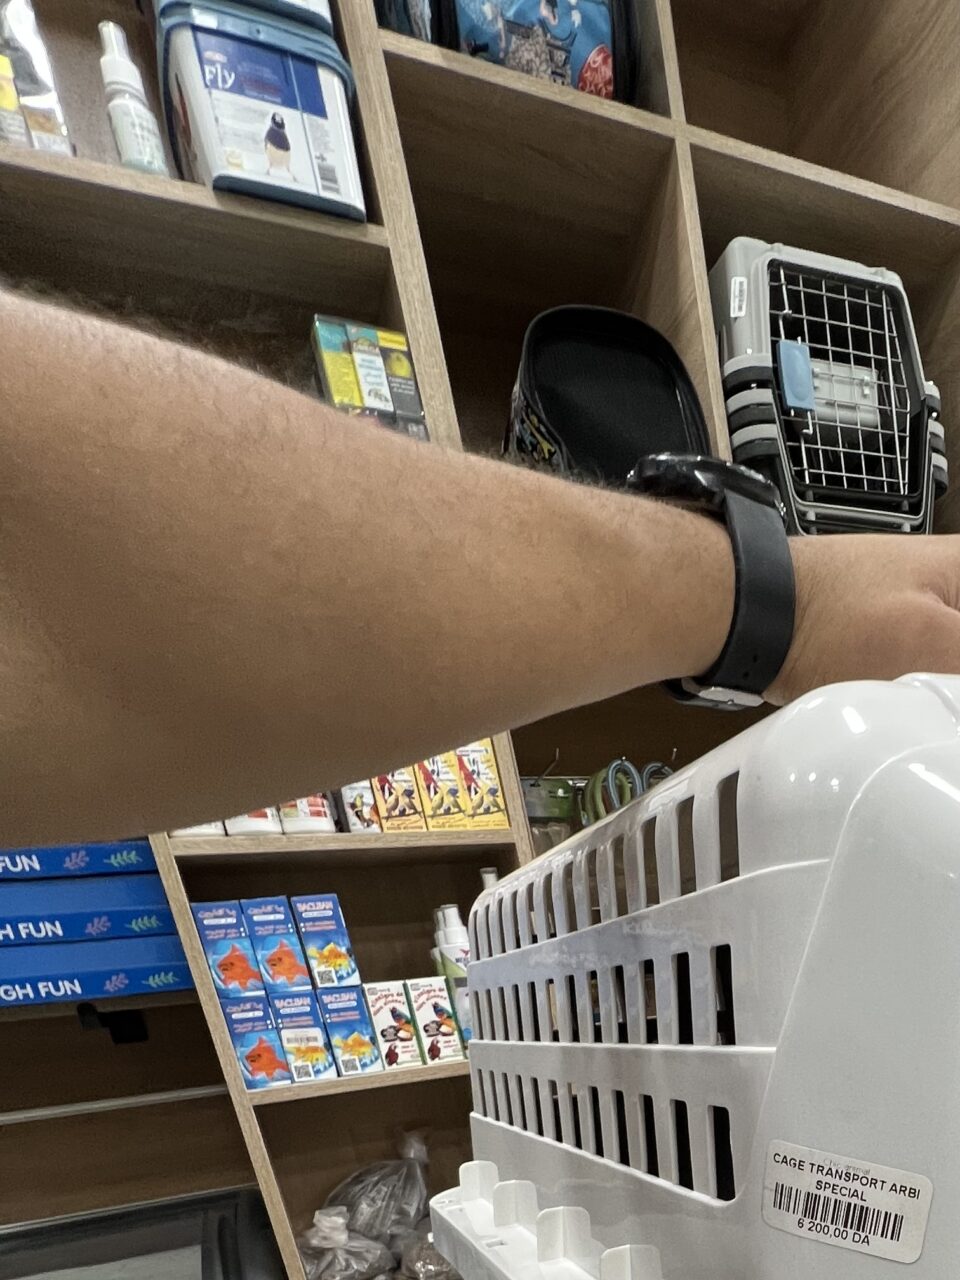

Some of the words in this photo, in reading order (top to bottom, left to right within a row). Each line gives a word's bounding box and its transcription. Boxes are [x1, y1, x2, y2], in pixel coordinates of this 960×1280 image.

[204, 63, 235, 89] Fly
[18, 920, 64, 939] FUN
[37, 979, 82, 998] FUN
[773, 1153, 806, 1171] CAGE
[809, 1163, 887, 1192] TRANSPORT
[889, 1183, 921, 1200] ARBI
[815, 1180, 867, 1202] SPECIAL
[797, 1218, 804, 1229] 6
[807, 1220, 849, 1240] 200,00
[852, 1232, 870, 1246] DA
